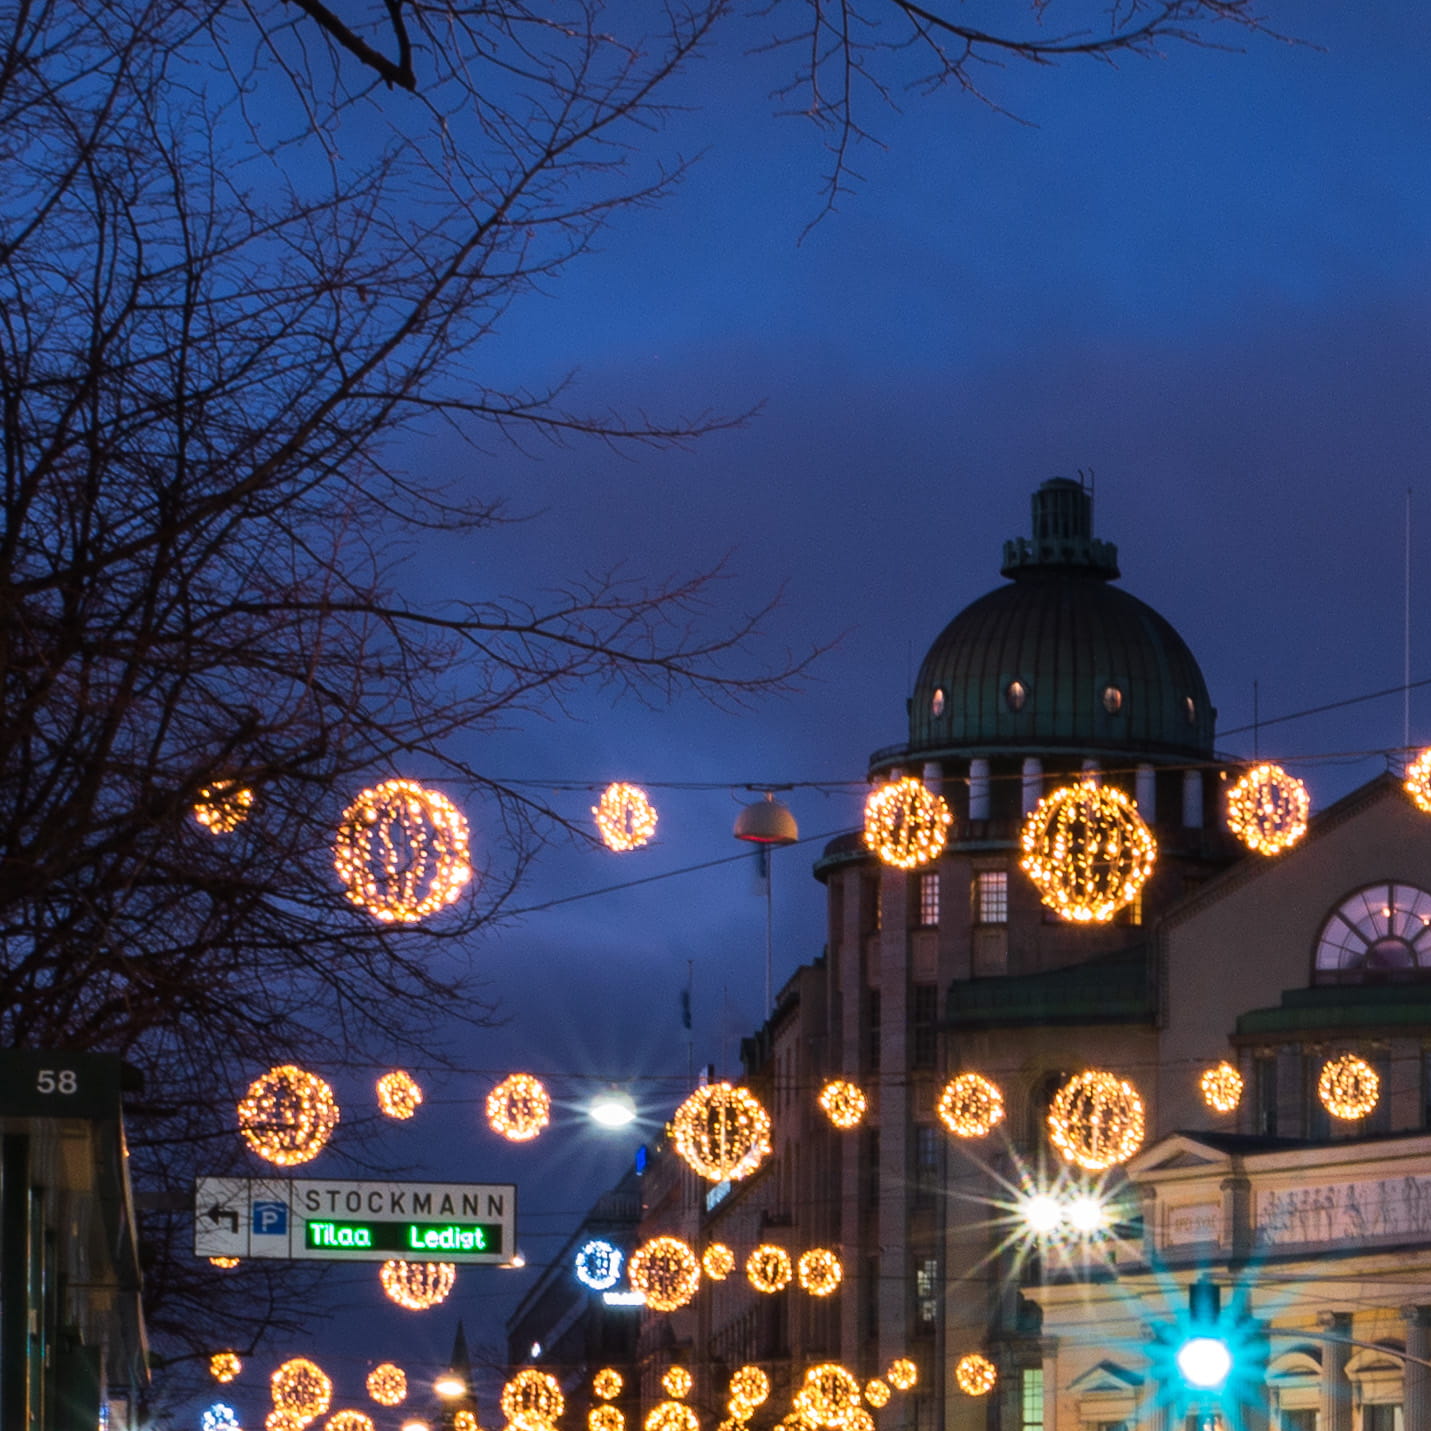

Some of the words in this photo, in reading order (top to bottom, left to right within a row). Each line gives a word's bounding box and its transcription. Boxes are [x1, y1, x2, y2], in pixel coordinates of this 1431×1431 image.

[37, 1070, 77, 1094] 58
[305, 1189, 505, 1217] STOCKMANN
[310, 1222, 372, 1247] Tilaa
[410, 1225, 486, 1250] Ledigt
